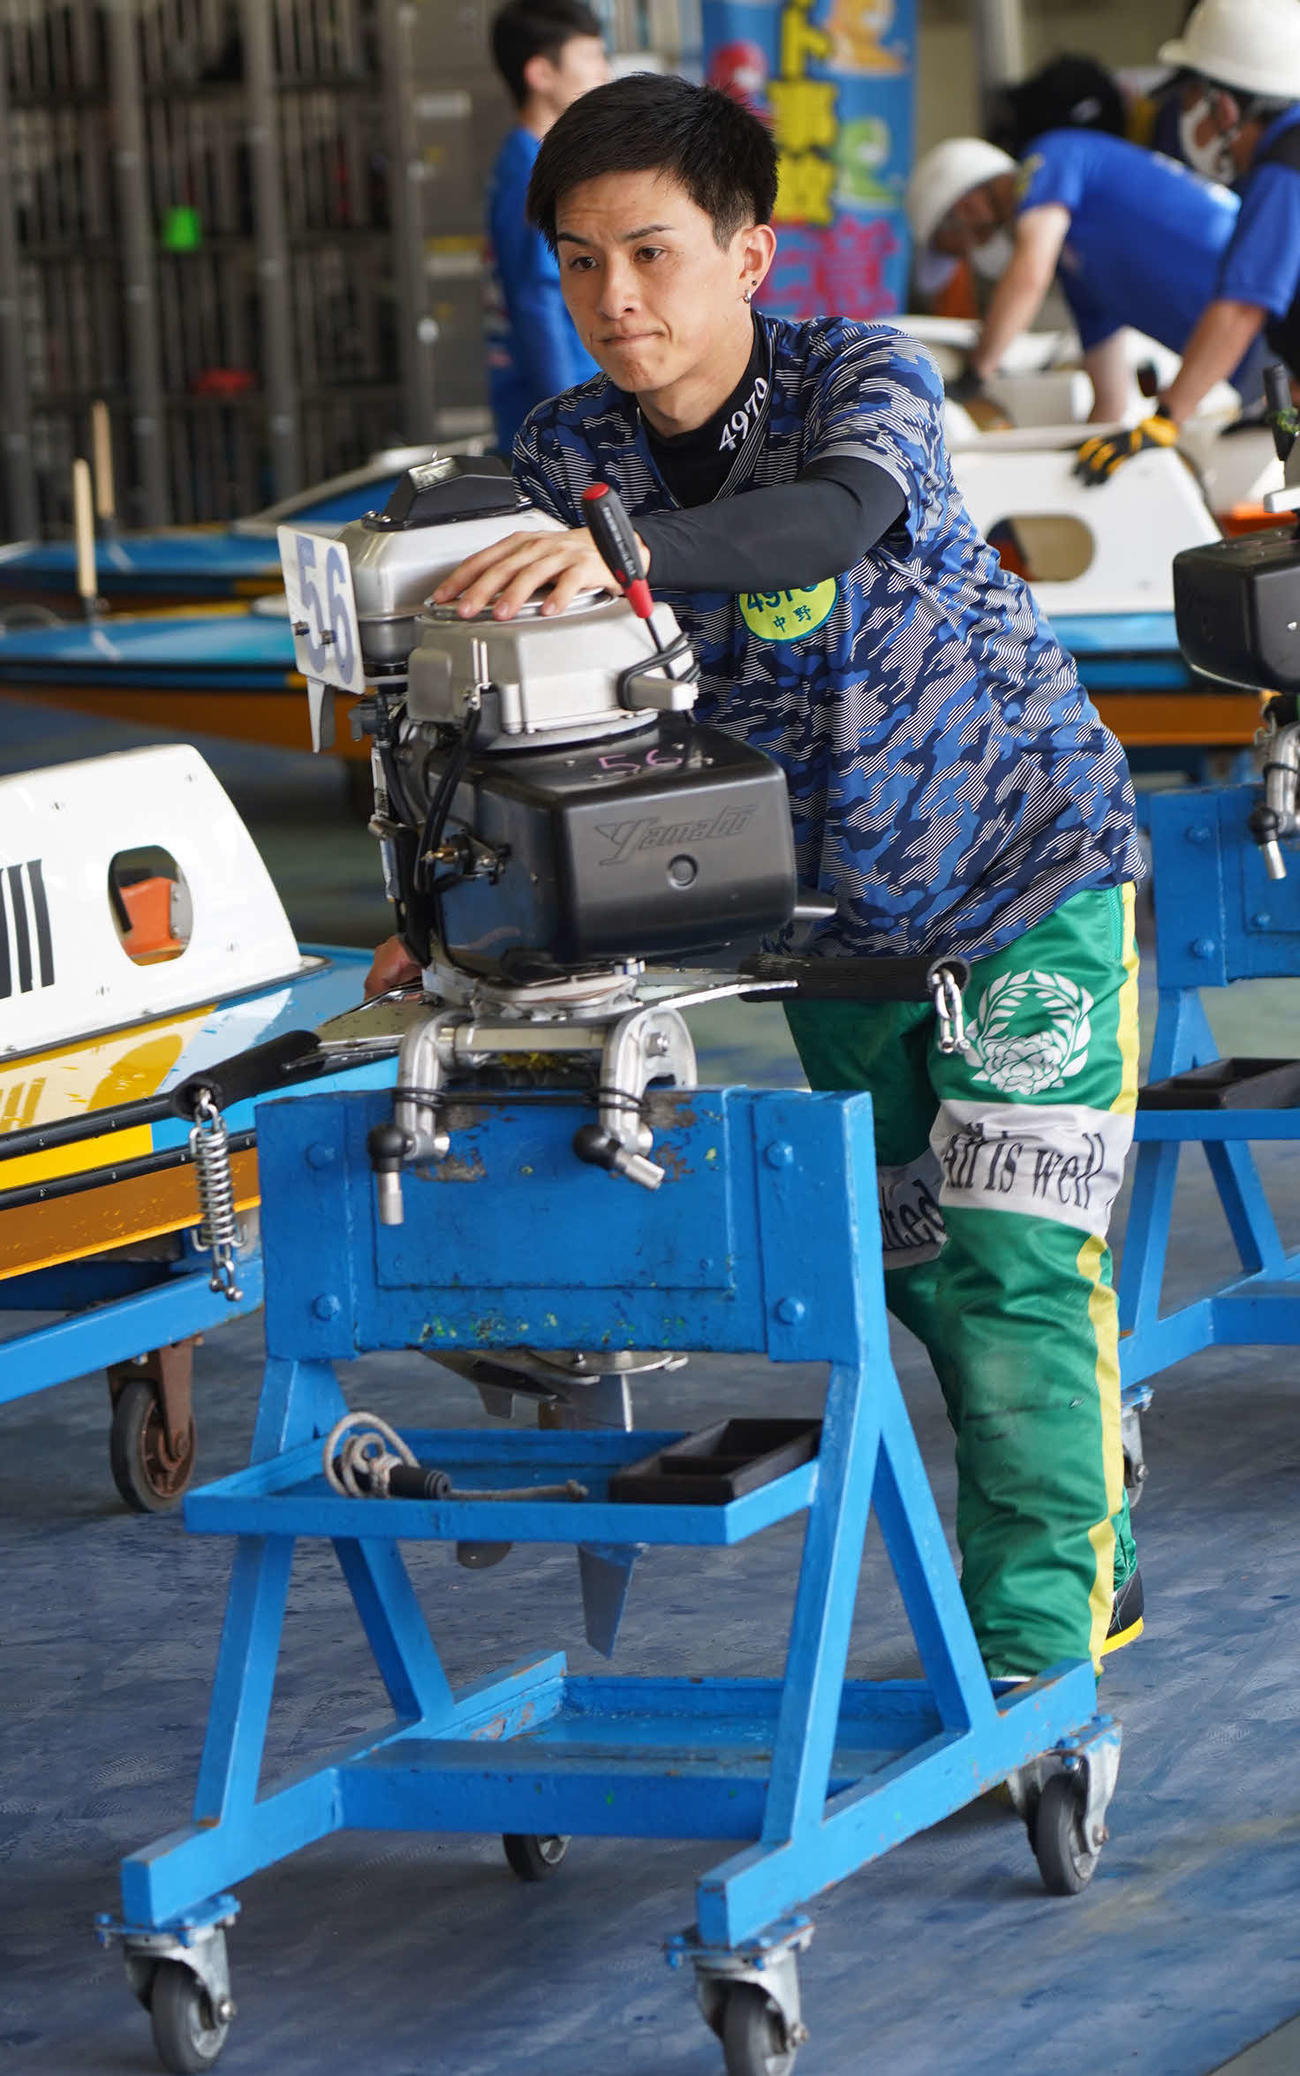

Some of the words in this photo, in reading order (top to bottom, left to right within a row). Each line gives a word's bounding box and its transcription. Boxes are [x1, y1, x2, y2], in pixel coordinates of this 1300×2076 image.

[718, 376, 768, 451] 4970
[295, 533, 355, 685] 56
[773, 604, 812, 633] 中野
[598, 749, 683, 771] 56
[983, 1130, 1024, 1194] is
[1032, 1132, 1104, 1210] well
